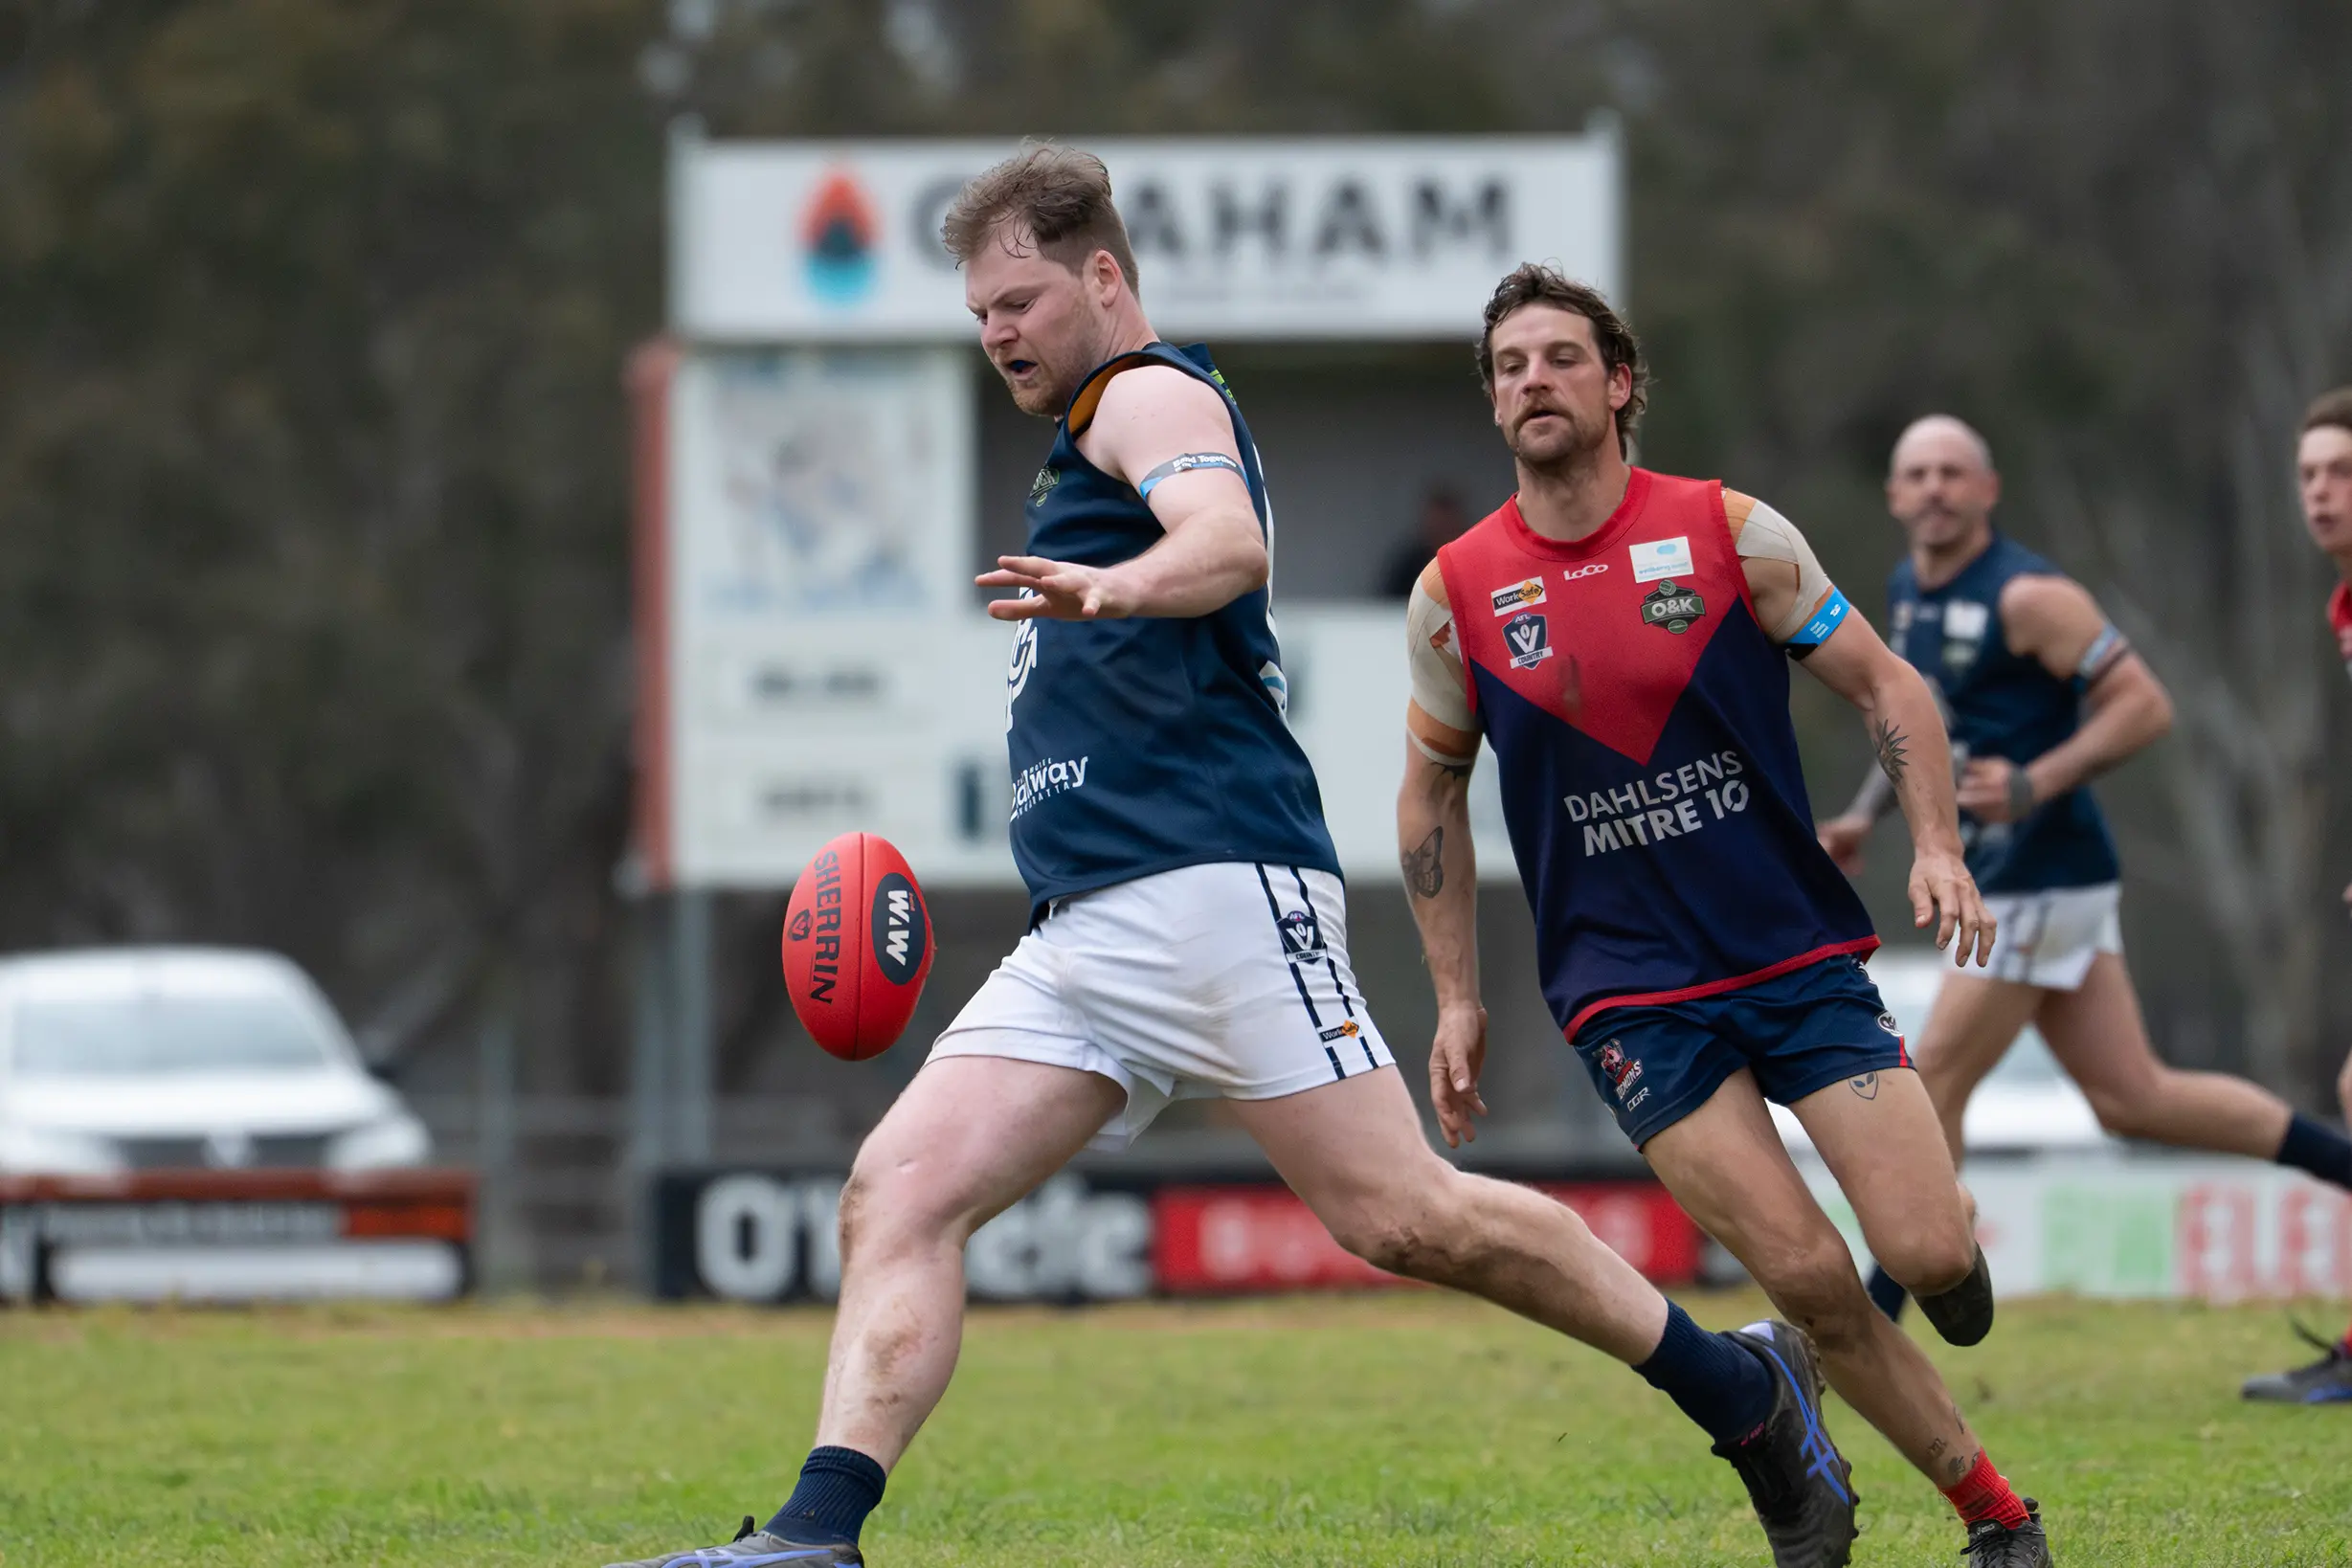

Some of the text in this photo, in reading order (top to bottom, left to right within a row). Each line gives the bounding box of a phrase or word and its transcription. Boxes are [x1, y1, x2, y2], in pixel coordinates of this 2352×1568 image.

[911, 175, 1512, 261] GAHAM
[1495, 586, 1540, 606] WorkSafe
[1514, 614, 1532, 623] AFL
[1651, 598, 1695, 617] O&K
[1517, 651, 1544, 664] COUNTRY
[1563, 750, 1743, 822] DAHLSENS
[1582, 779, 1749, 858] MITRE 10
[811, 850, 841, 1005] SHERRIN
